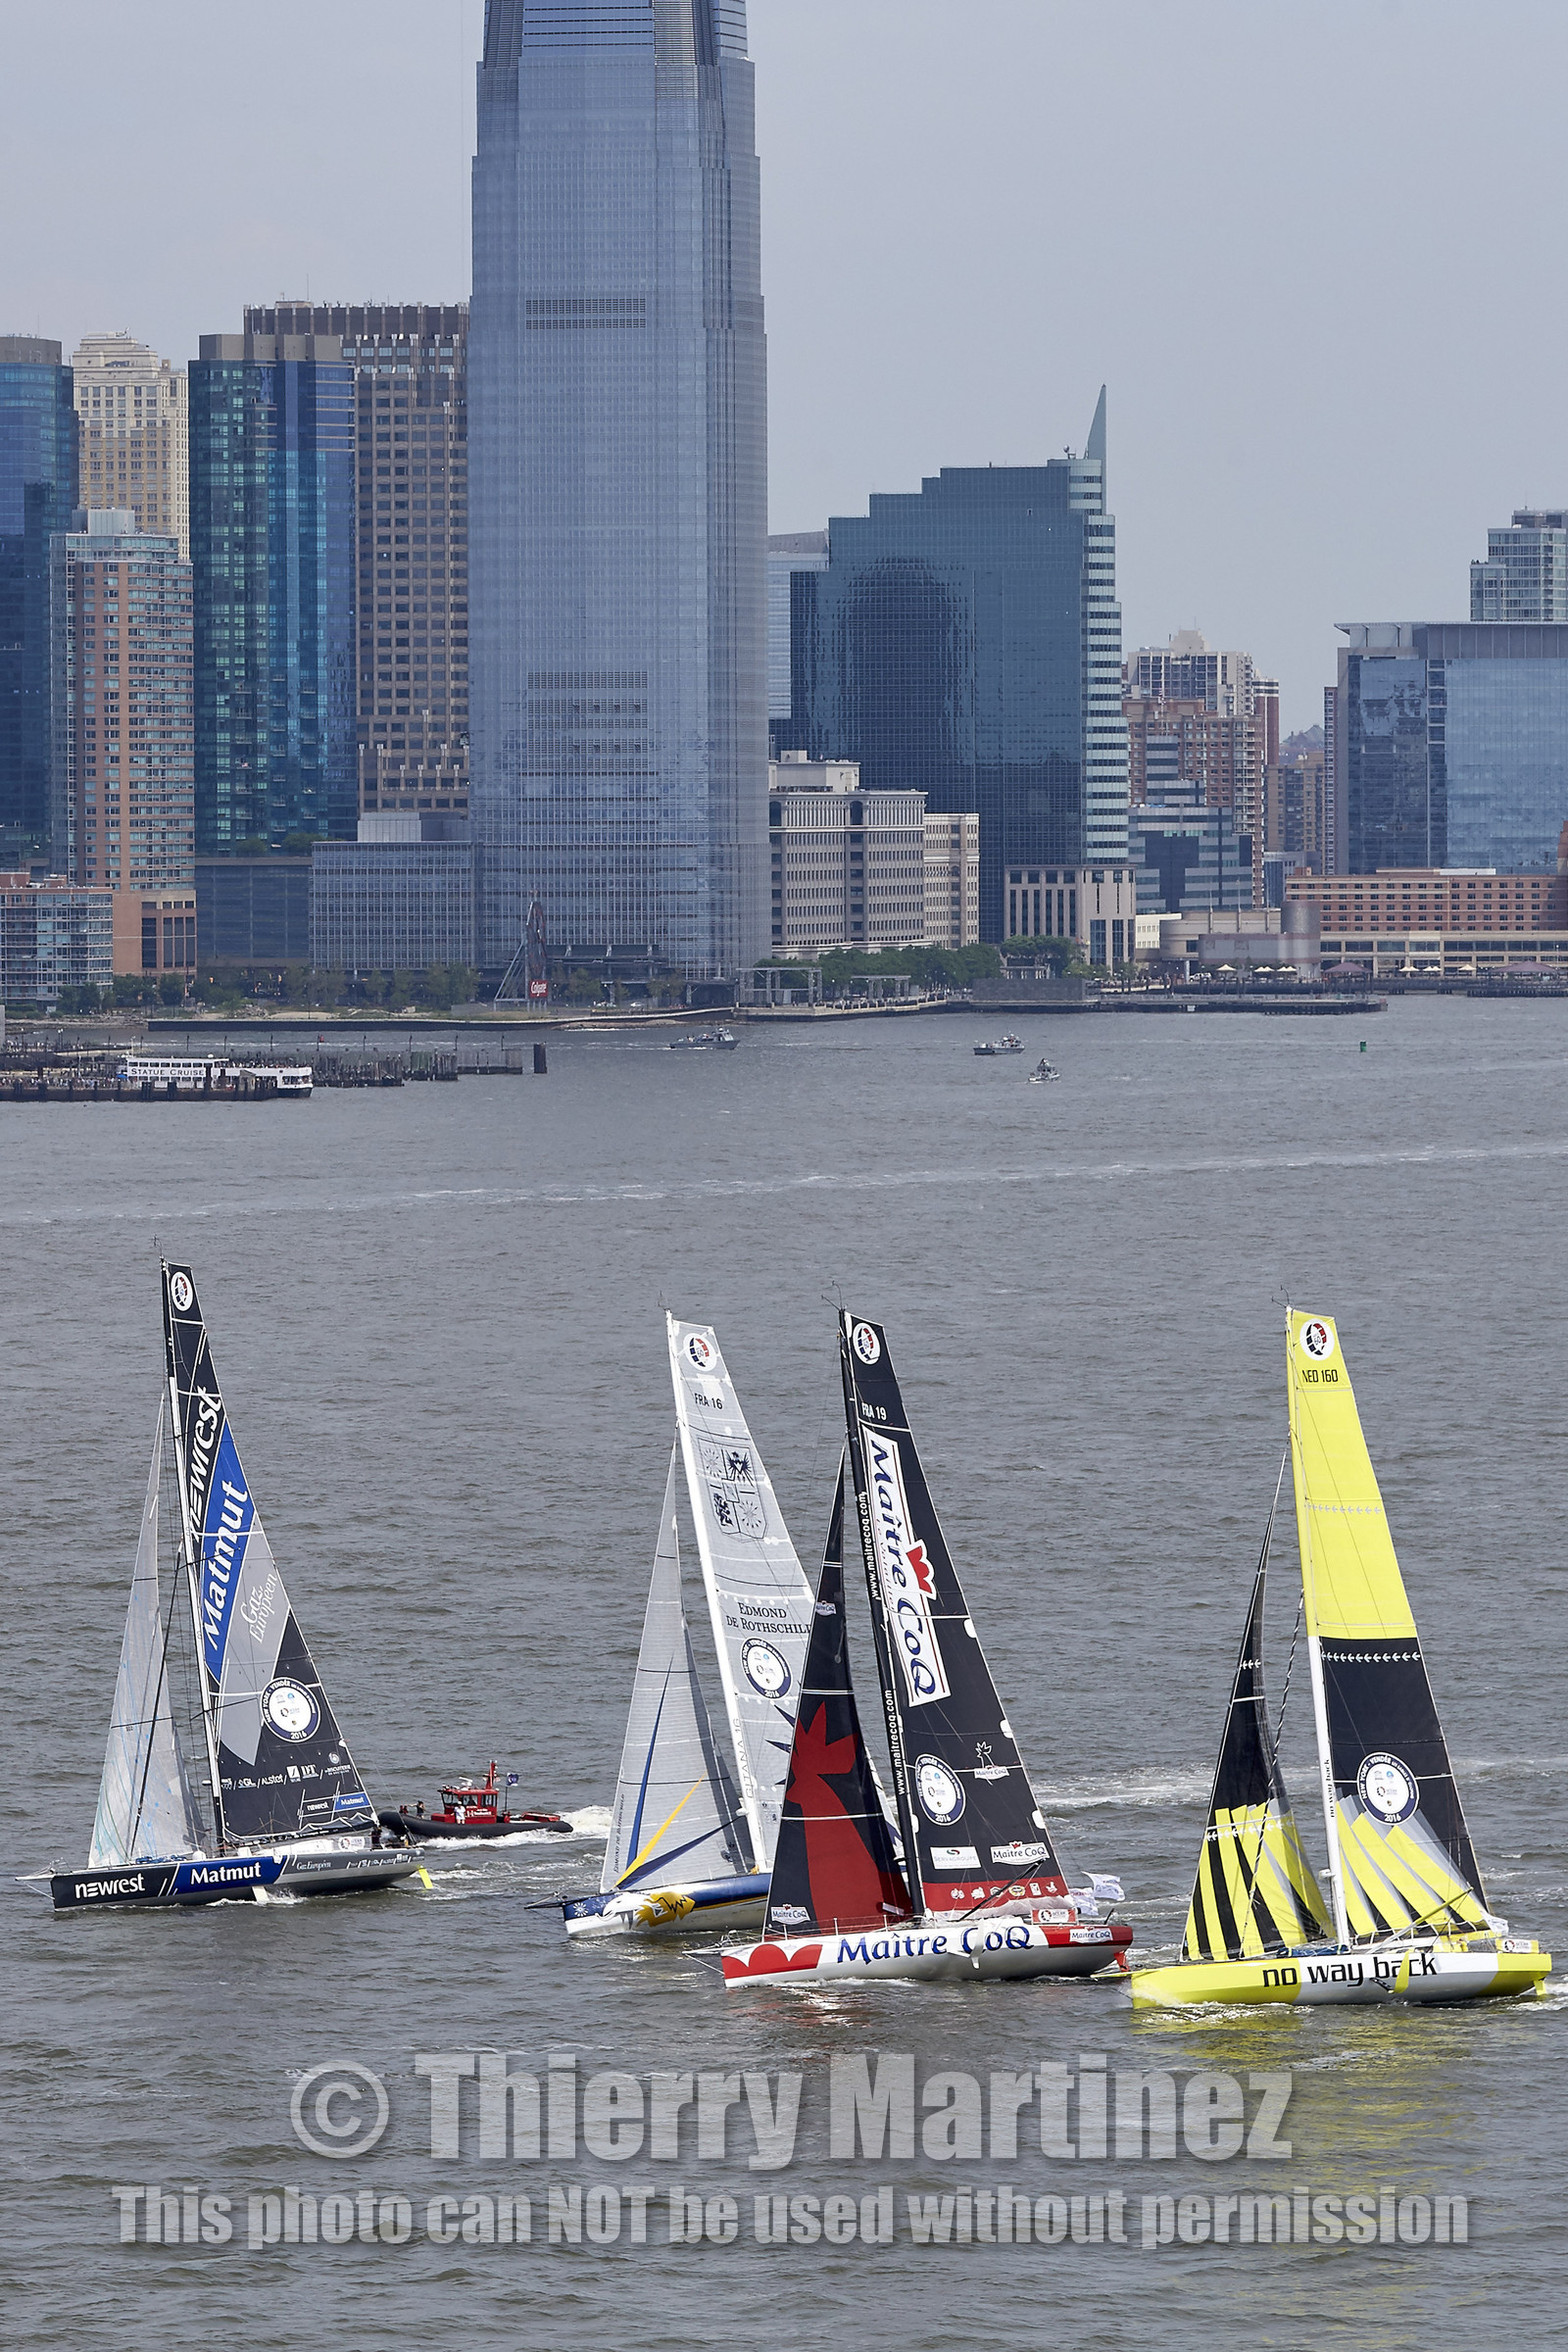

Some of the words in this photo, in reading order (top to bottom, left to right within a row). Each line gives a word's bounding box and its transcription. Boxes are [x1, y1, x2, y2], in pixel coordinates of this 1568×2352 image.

[1301, 1369, 1319, 1383] NED
[1321, 1369, 1339, 1383] 160
[694, 1393, 710, 1407] FRA
[711, 1397, 723, 1410] 16
[861, 1402, 875, 1418] FRA
[875, 1405, 887, 1421] 19
[858, 1491, 881, 1599] www.maitrecoq.com
[202, 1480, 249, 1651] Matmut
[870, 1439, 907, 1588] Maître
[897, 1596, 937, 1699] CoQ
[240, 1586, 264, 1625] Gaz
[249, 1573, 278, 1644] Européen
[738, 1601, 787, 1619] EDMOND
[725, 1615, 740, 1628] DE
[290, 1731, 308, 1740] 2016
[884, 1689, 906, 1795] www.maitrecoq.com
[1360, 1764, 1369, 1782] YORK
[340, 1796, 365, 1806] Matmut
[1359, 1784, 1368, 1799] NEW
[1024, 1846, 1047, 1857] CoQ
[190, 1861, 262, 1886] Matmut
[74, 1873, 145, 1899] newrest
[836, 1933, 948, 1965] Maître
[960, 1925, 1034, 1954] CoQ
[1262, 1967, 1298, 1987] no
[1307, 1962, 1363, 1987] way
[1373, 1952, 1438, 1980] back
